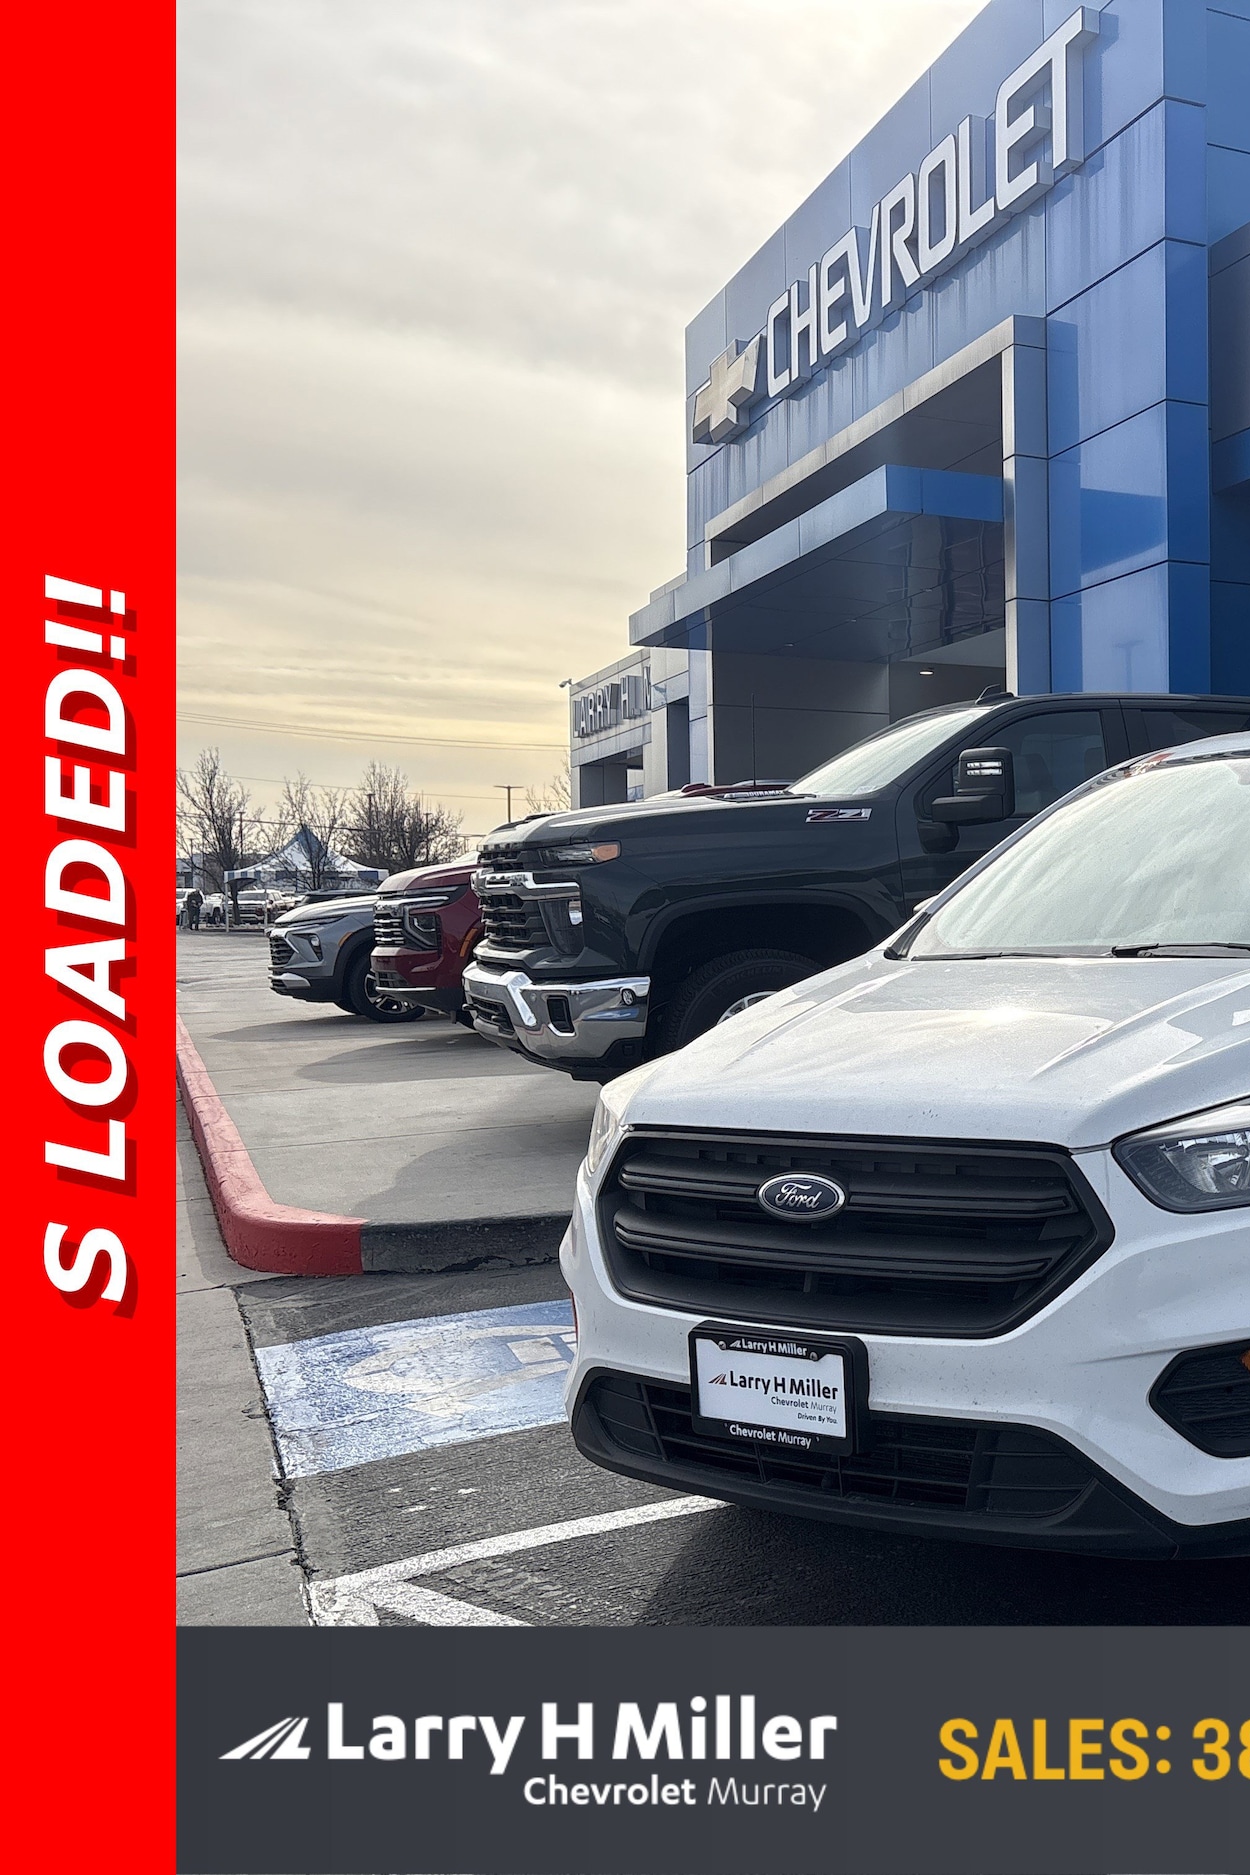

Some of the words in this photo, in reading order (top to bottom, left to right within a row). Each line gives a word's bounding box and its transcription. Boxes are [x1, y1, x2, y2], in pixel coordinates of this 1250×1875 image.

[767, 6, 1092, 398] CHEVROLET
[573, 683, 614, 738] LARRY
[774, 1182, 822, 1209] Ford
[741, 1338, 767, 1354] Larry
[768, 1341, 777, 1352] H
[778, 1343, 807, 1356] Miller
[730, 1370, 770, 1395] Larry
[774, 1376, 786, 1393] H
[790, 1378, 838, 1400] Miller
[771, 1396, 809, 1409] Chevrolet
[811, 1401, 837, 1414] Murray
[797, 1412, 817, 1421] Driven
[818, 1415, 826, 1424] By
[729, 1424, 776, 1441] Chevrolet
[778, 1431, 812, 1449] Murray
